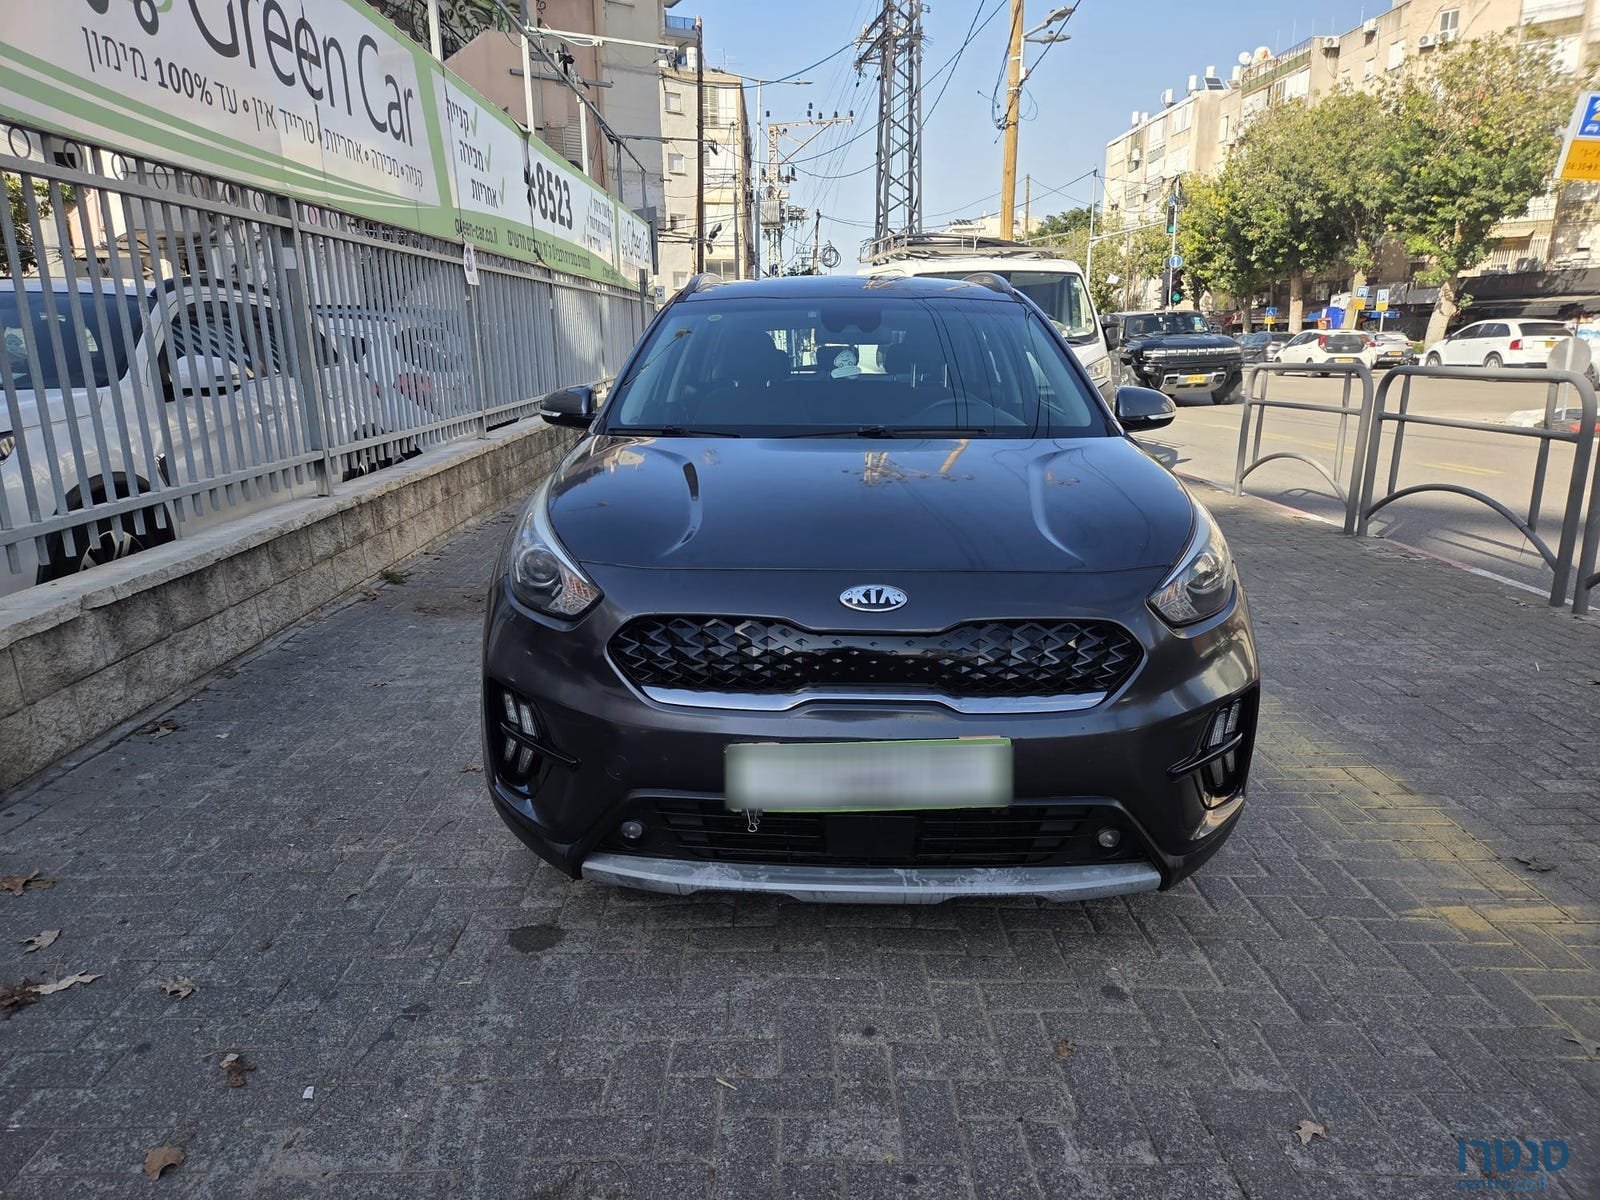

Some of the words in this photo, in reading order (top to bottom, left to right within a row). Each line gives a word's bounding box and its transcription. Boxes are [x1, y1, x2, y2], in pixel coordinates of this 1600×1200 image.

[82, 26, 148, 81] מימון
[154, 57, 213, 105] 100%
[214, 81, 238, 114] עד
[358, 34, 413, 147] Car
[252, 97, 277, 131] אין
[279, 108, 315, 144] טרייד
[324, 128, 364, 165] אחריות
[459, 140, 484, 172] מכירה
[371, 149, 400, 178] מכירה
[405, 164, 423, 192] קניה
[471, 178, 498, 208] אחריות
[845, 586, 902, 605] KIA
